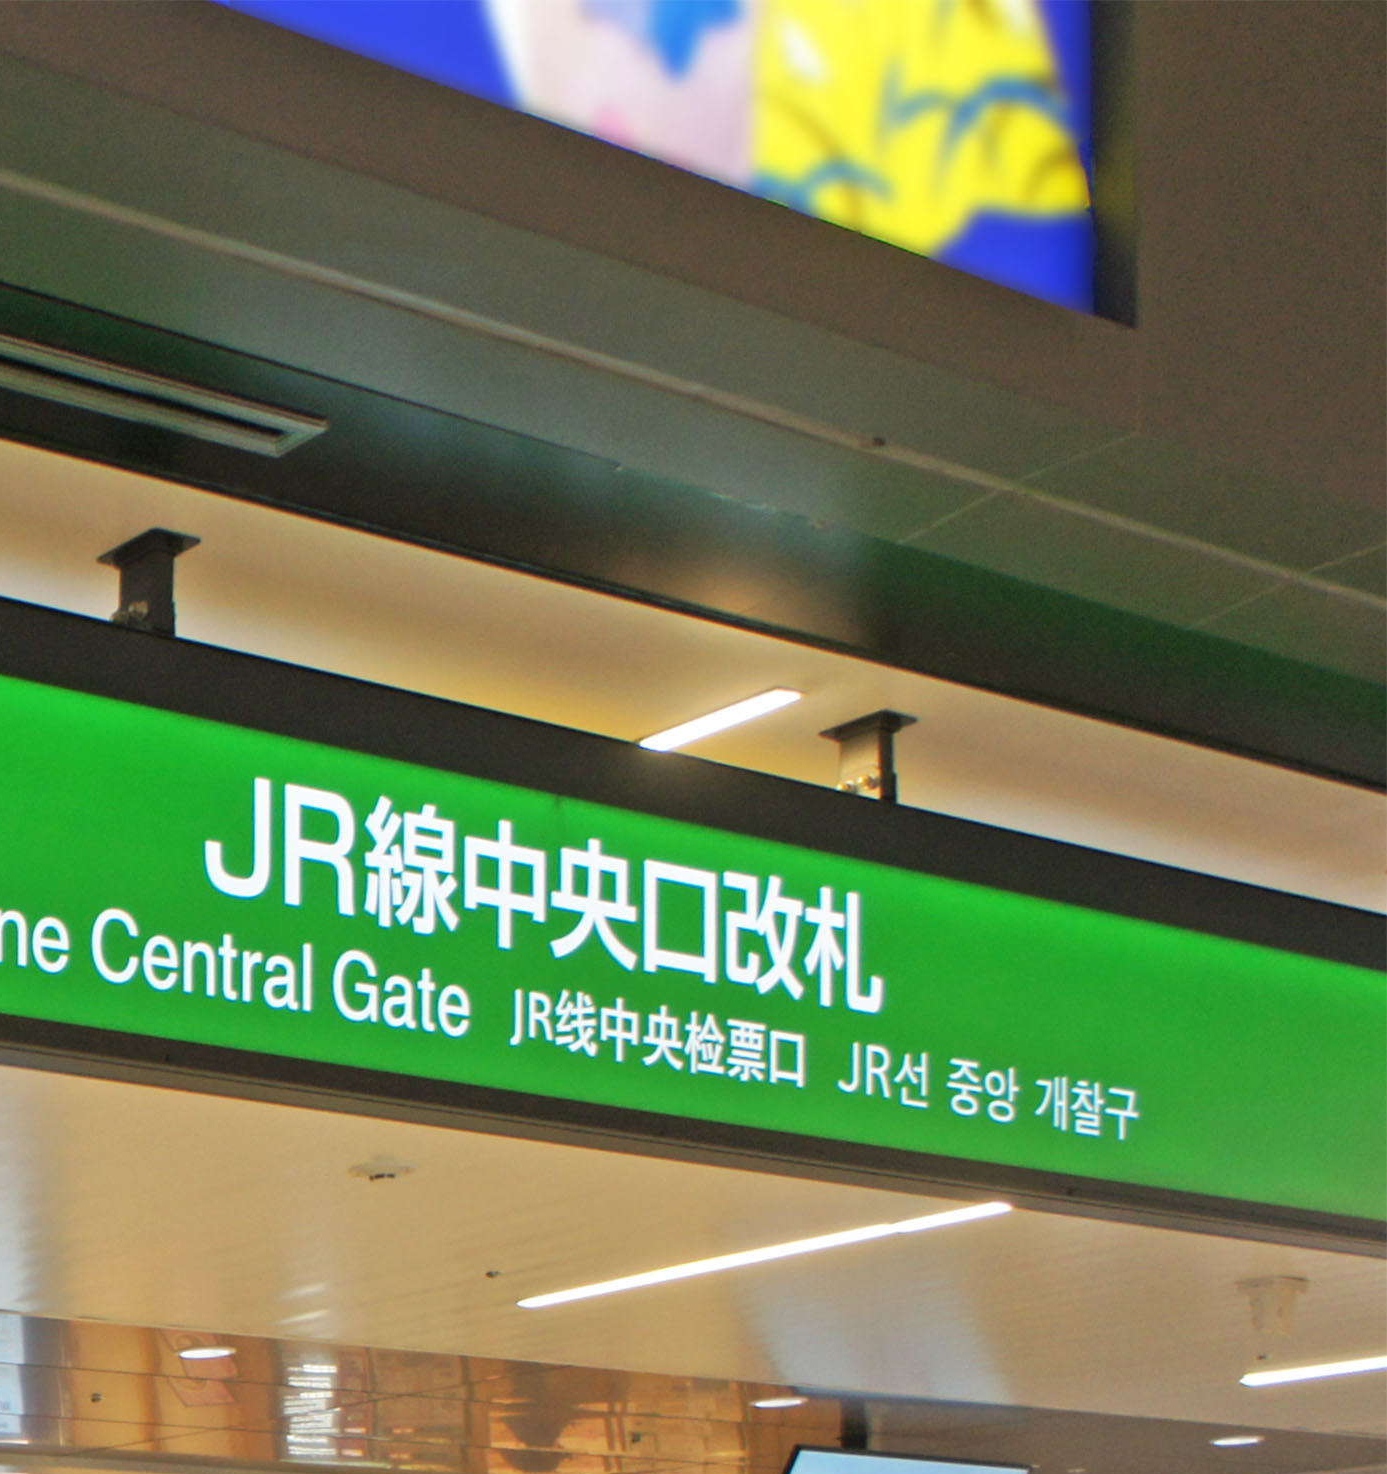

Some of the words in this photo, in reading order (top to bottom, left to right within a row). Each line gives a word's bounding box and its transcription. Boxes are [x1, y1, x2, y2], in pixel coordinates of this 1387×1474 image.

[204, 777, 884, 1015] JR線中央口改札
[91, 907, 313, 1013] Central
[332, 949, 472, 1038] Gate
[510, 988, 807, 1088] JR线中央检票口
[838, 1042, 930, 1109] JR선
[946, 1058, 1020, 1123] 중앙
[1034, 1075, 1139, 1141] 개찰구
